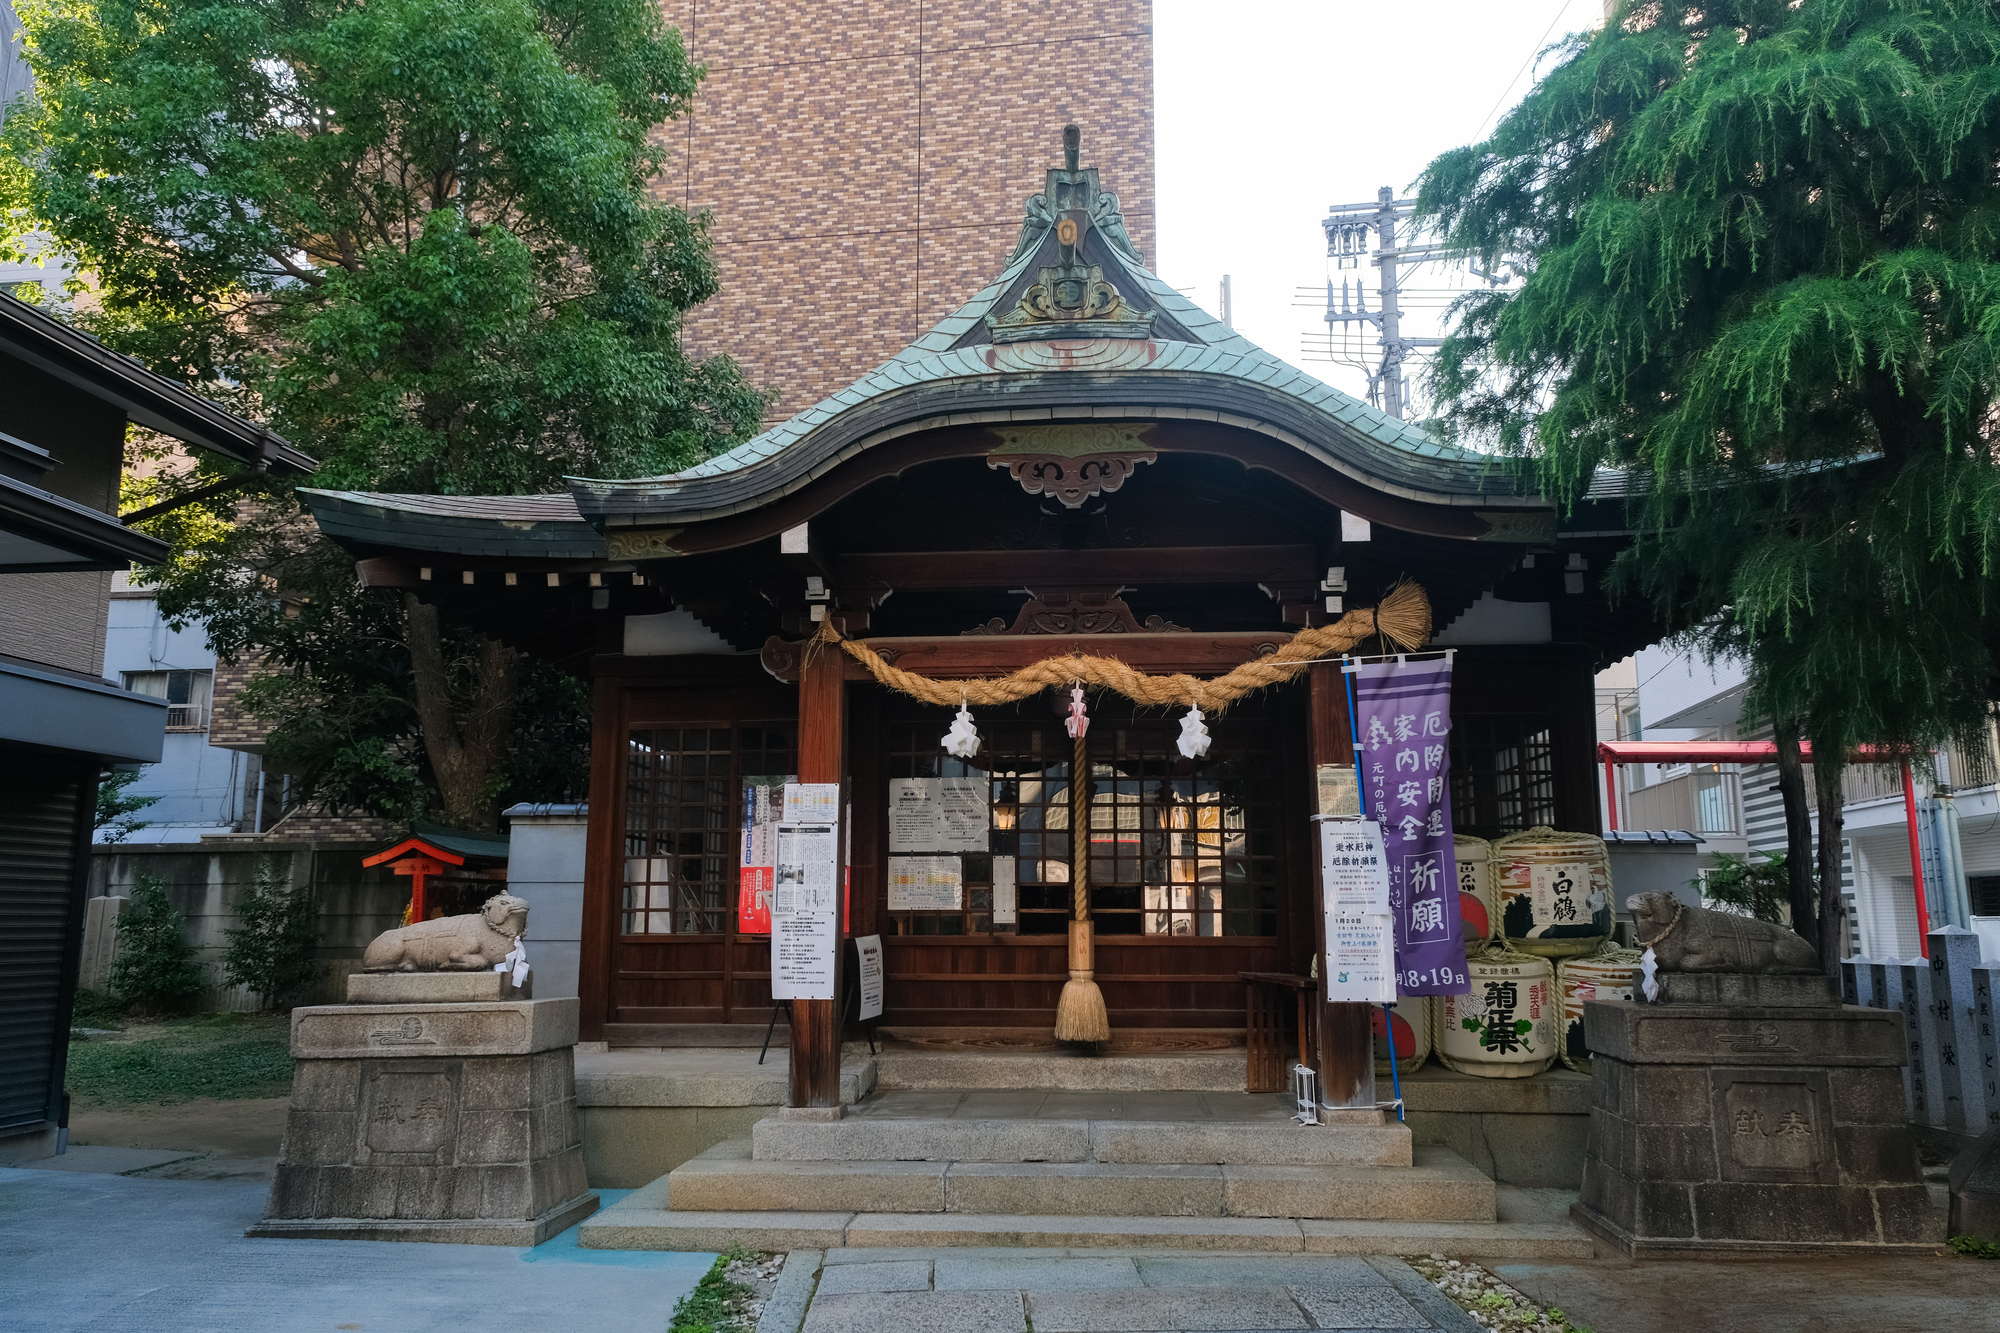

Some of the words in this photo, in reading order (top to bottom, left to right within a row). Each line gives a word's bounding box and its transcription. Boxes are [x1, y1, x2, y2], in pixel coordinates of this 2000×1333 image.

[1372, 762, 1390, 848] 元町の厄神さん
[1393, 714, 1425, 841] 家内安全
[1422, 710, 1449, 837] 厄除開運
[1335, 842, 1374, 852] 走水厄神
[1409, 858, 1444, 933] 祈願
[1552, 870, 1577, 922] 白鶴
[1483, 980, 1519, 1055] 菊正宗
